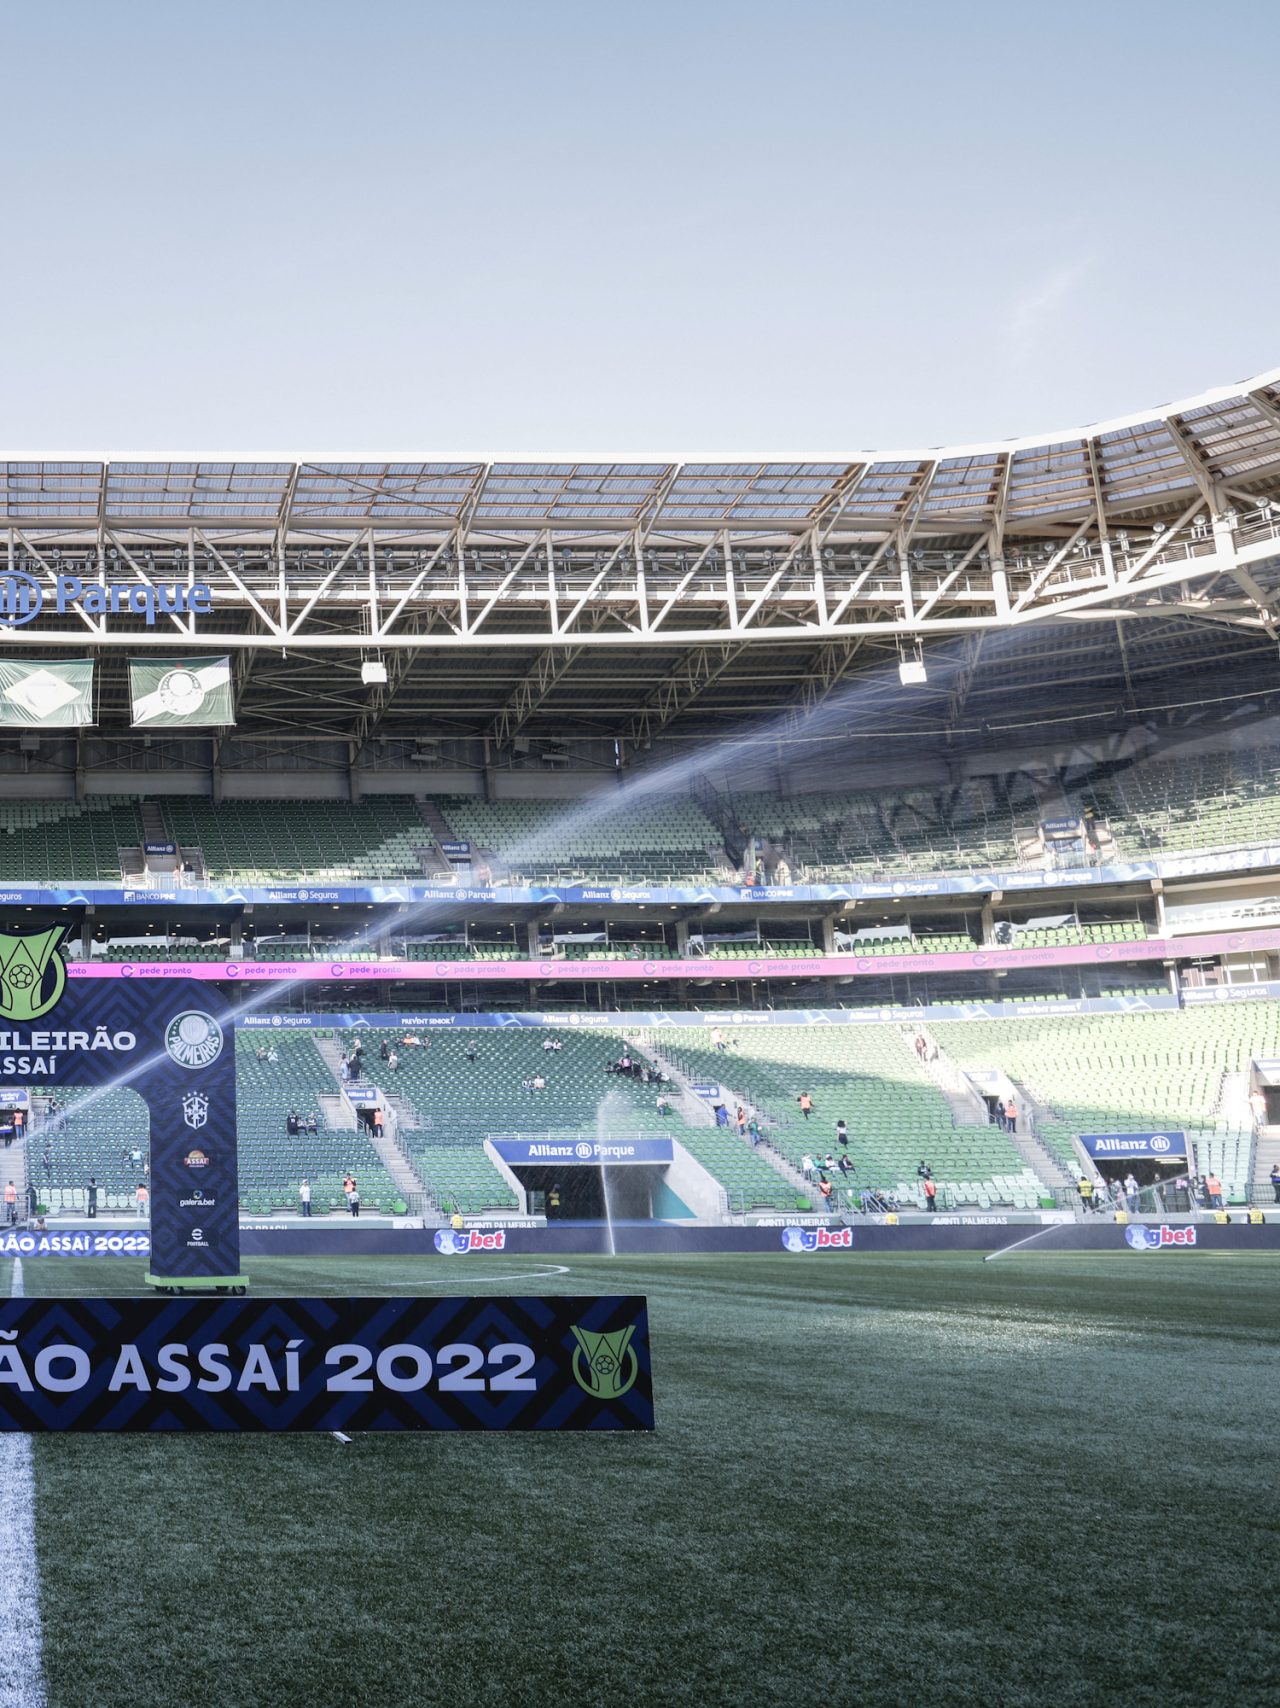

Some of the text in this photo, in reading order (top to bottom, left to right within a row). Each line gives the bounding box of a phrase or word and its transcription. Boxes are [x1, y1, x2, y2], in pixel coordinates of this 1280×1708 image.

[57, 576, 212, 624] Parque
[906, 883, 938, 894] Seguros
[310, 892, 338, 900] Seguros
[424, 890, 496, 901] Allianz Parque
[622, 891, 650, 900] Seguros
[994, 952, 1054, 964] pede pronto
[662, 964, 714, 973] pede pronto
[768, 962, 820, 972] pede pronto
[877, 958, 934, 969] pede pronto
[140, 966, 192, 975] pede pronto
[244, 966, 296, 975] pede pronto
[350, 966, 402, 974] pede pronto
[454, 965, 506, 974] pede pronto
[558, 964, 610, 974] pede pronto
[1229, 988, 1267, 998] Seguros
[580, 1015, 608, 1024] Seguros
[704, 1014, 768, 1024] Allianz Parque
[850, 1010, 923, 1020] Allianz Seguros
[244, 1016, 312, 1026] Allianz Seguros
[168, 1036, 220, 1064] PALMEIRAS
[1096, 1140, 1148, 1150] Allianz
[529, 1144, 634, 1158] Allianz Parque
[180, 1199, 215, 1207] galera.bet
[786, 1218, 830, 1226] PALMEIRAS
[39, 1235, 90, 1250] ASSAÍ
[95, 1237, 149, 1250] 2022
[109, 1339, 304, 1392] ASSAÍ
[324, 1343, 536, 1392] 2022
